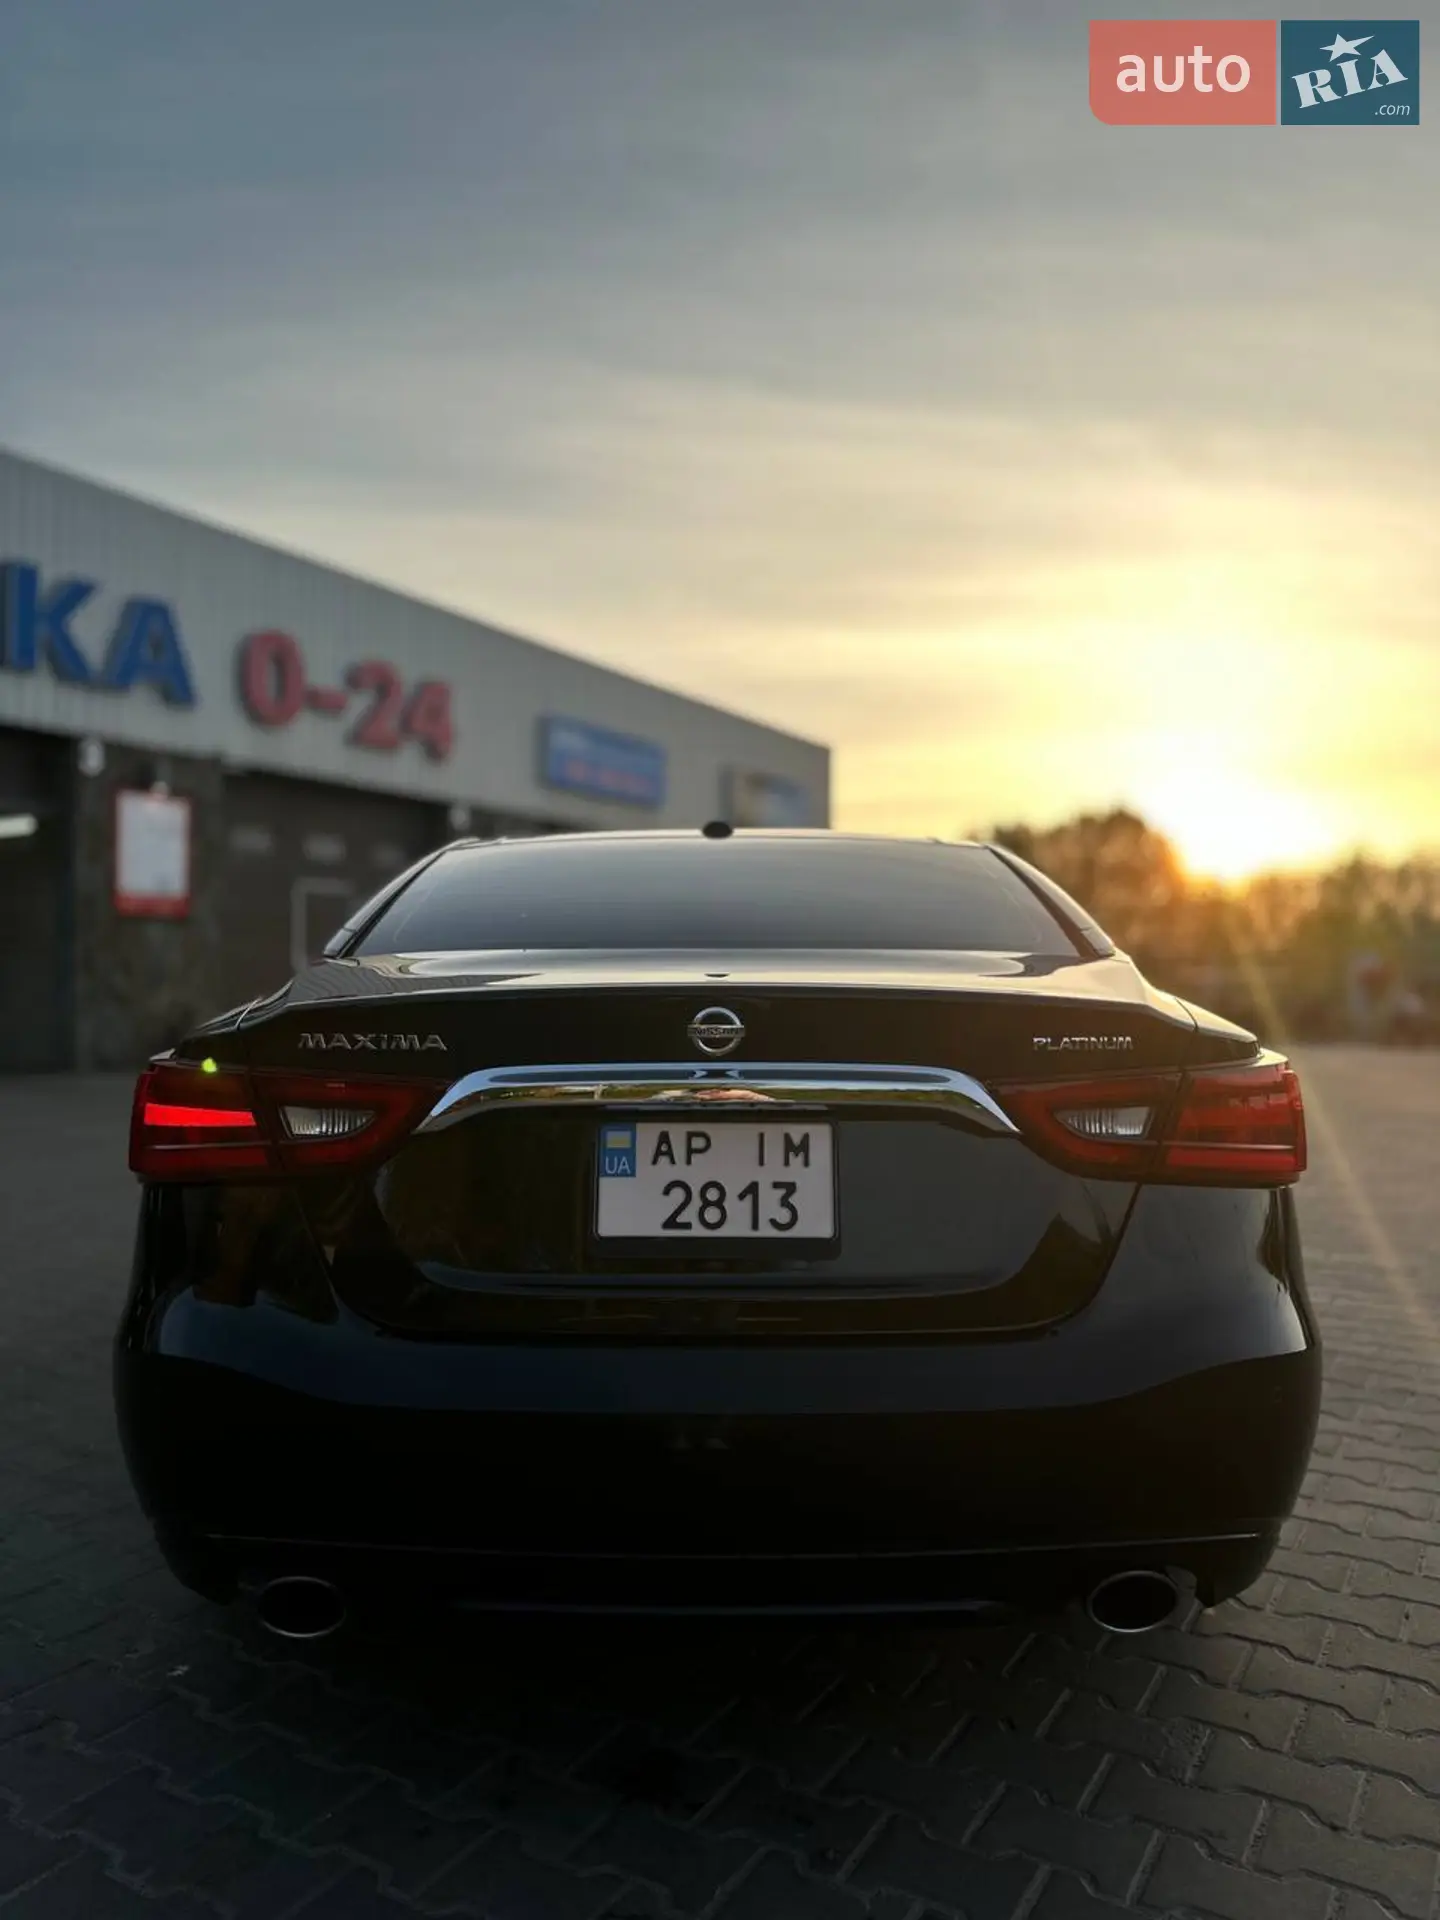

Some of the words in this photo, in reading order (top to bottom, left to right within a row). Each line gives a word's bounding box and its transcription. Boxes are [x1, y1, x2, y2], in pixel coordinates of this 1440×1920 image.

[238, 628, 453, 760] 0-24
[298, 1032, 448, 1051] MAXIMA
[1032, 1036, 1134, 1051] PLATINUM
[651, 1130, 712, 1167] AP
[757, 1131, 811, 1168] IM
[605, 1156, 631, 1175] UA
[661, 1180, 799, 1232] 2813
